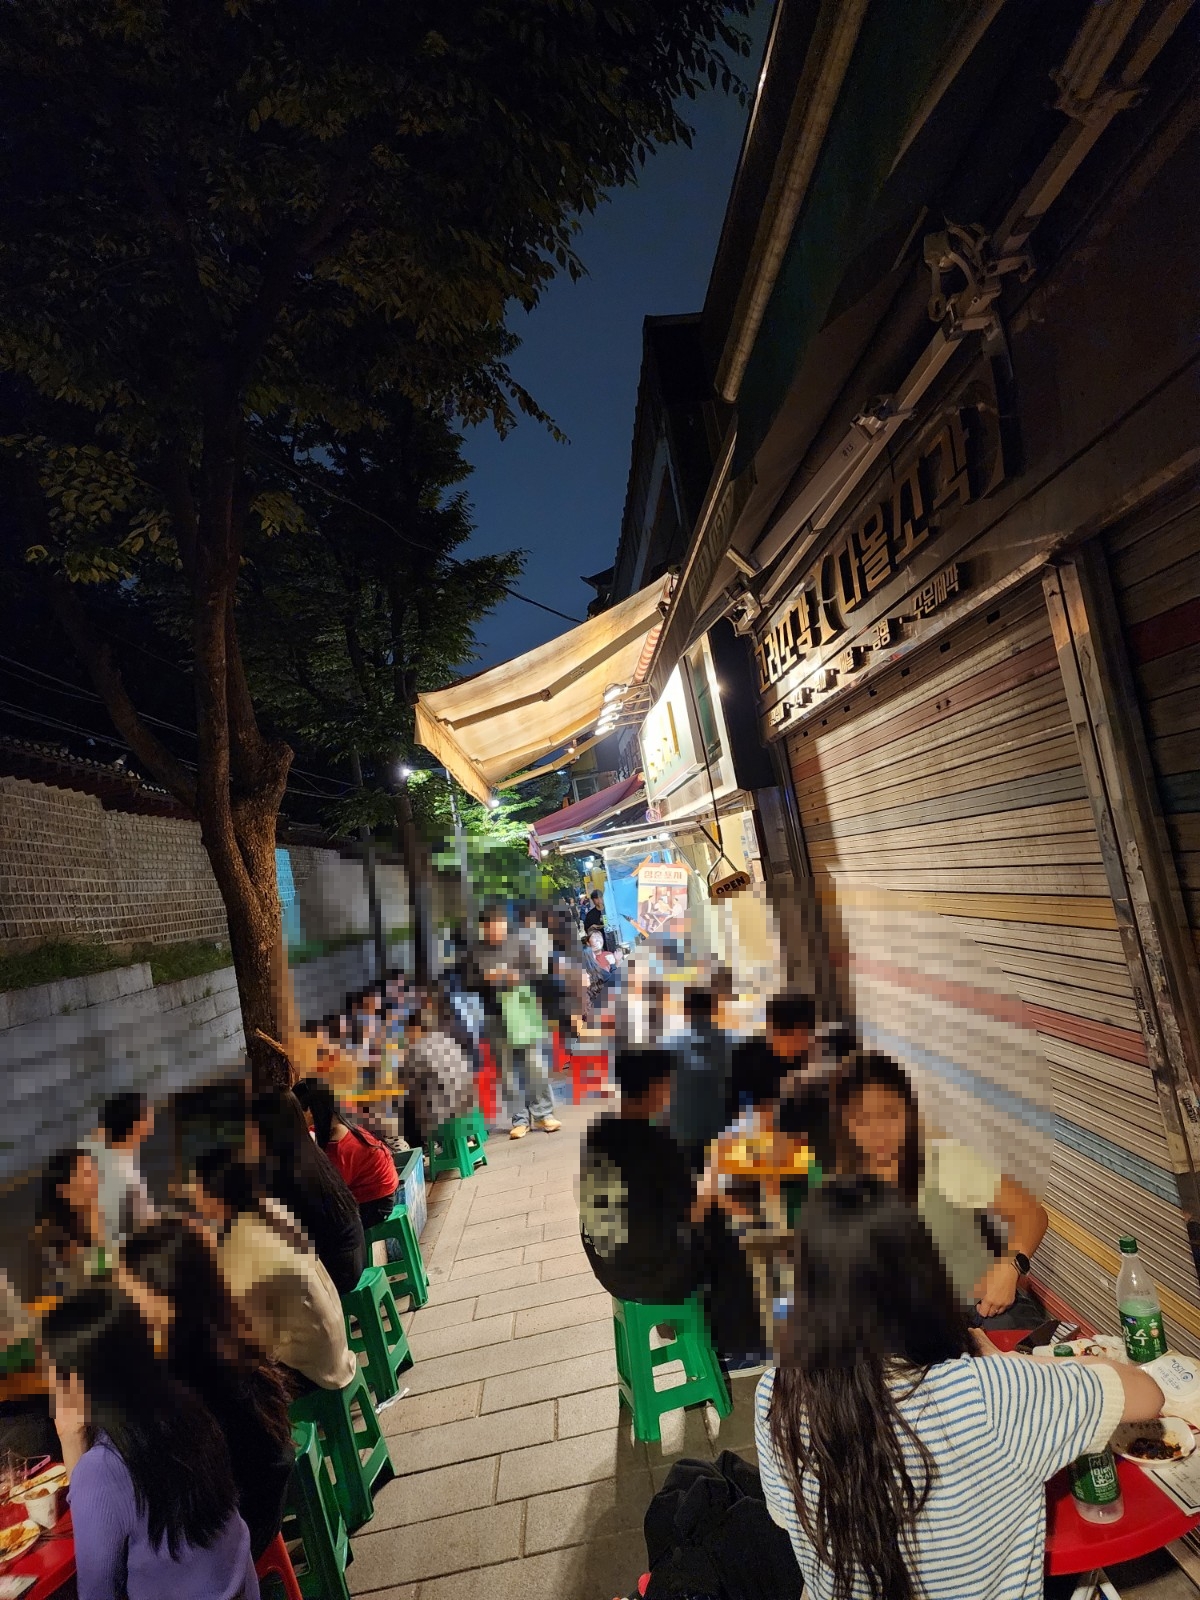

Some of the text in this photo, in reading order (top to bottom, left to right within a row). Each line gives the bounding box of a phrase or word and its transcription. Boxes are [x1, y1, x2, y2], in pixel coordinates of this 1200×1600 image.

[755, 591, 813, 694] 고려조각
[872, 618, 890, 651] 금형
[913, 562, 959, 620] 주문제작
[715, 876, 746, 895] OPEN
